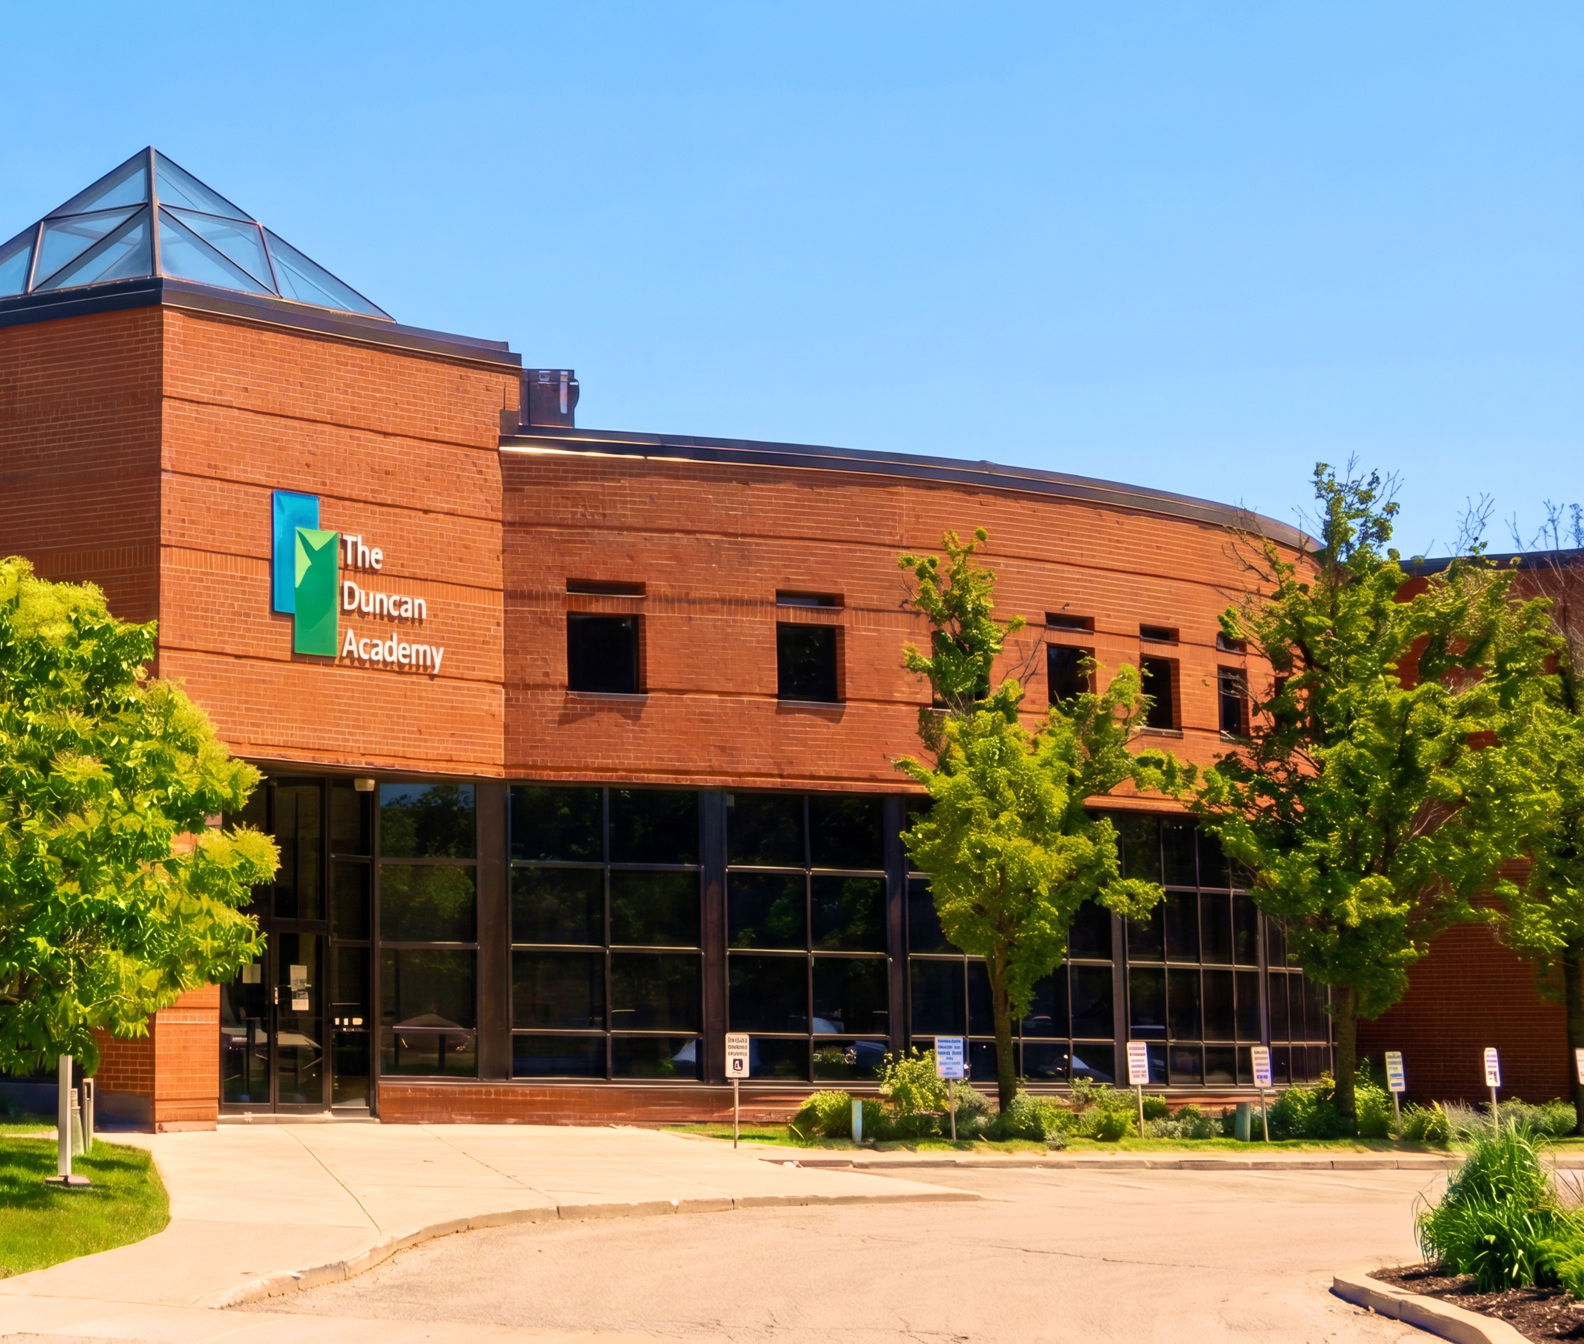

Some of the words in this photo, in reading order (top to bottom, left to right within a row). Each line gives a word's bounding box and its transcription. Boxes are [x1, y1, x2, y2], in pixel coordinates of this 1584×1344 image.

[342, 534, 383, 569] The
[343, 581, 427, 619] Duncan
[342, 629, 444, 674] Academy
